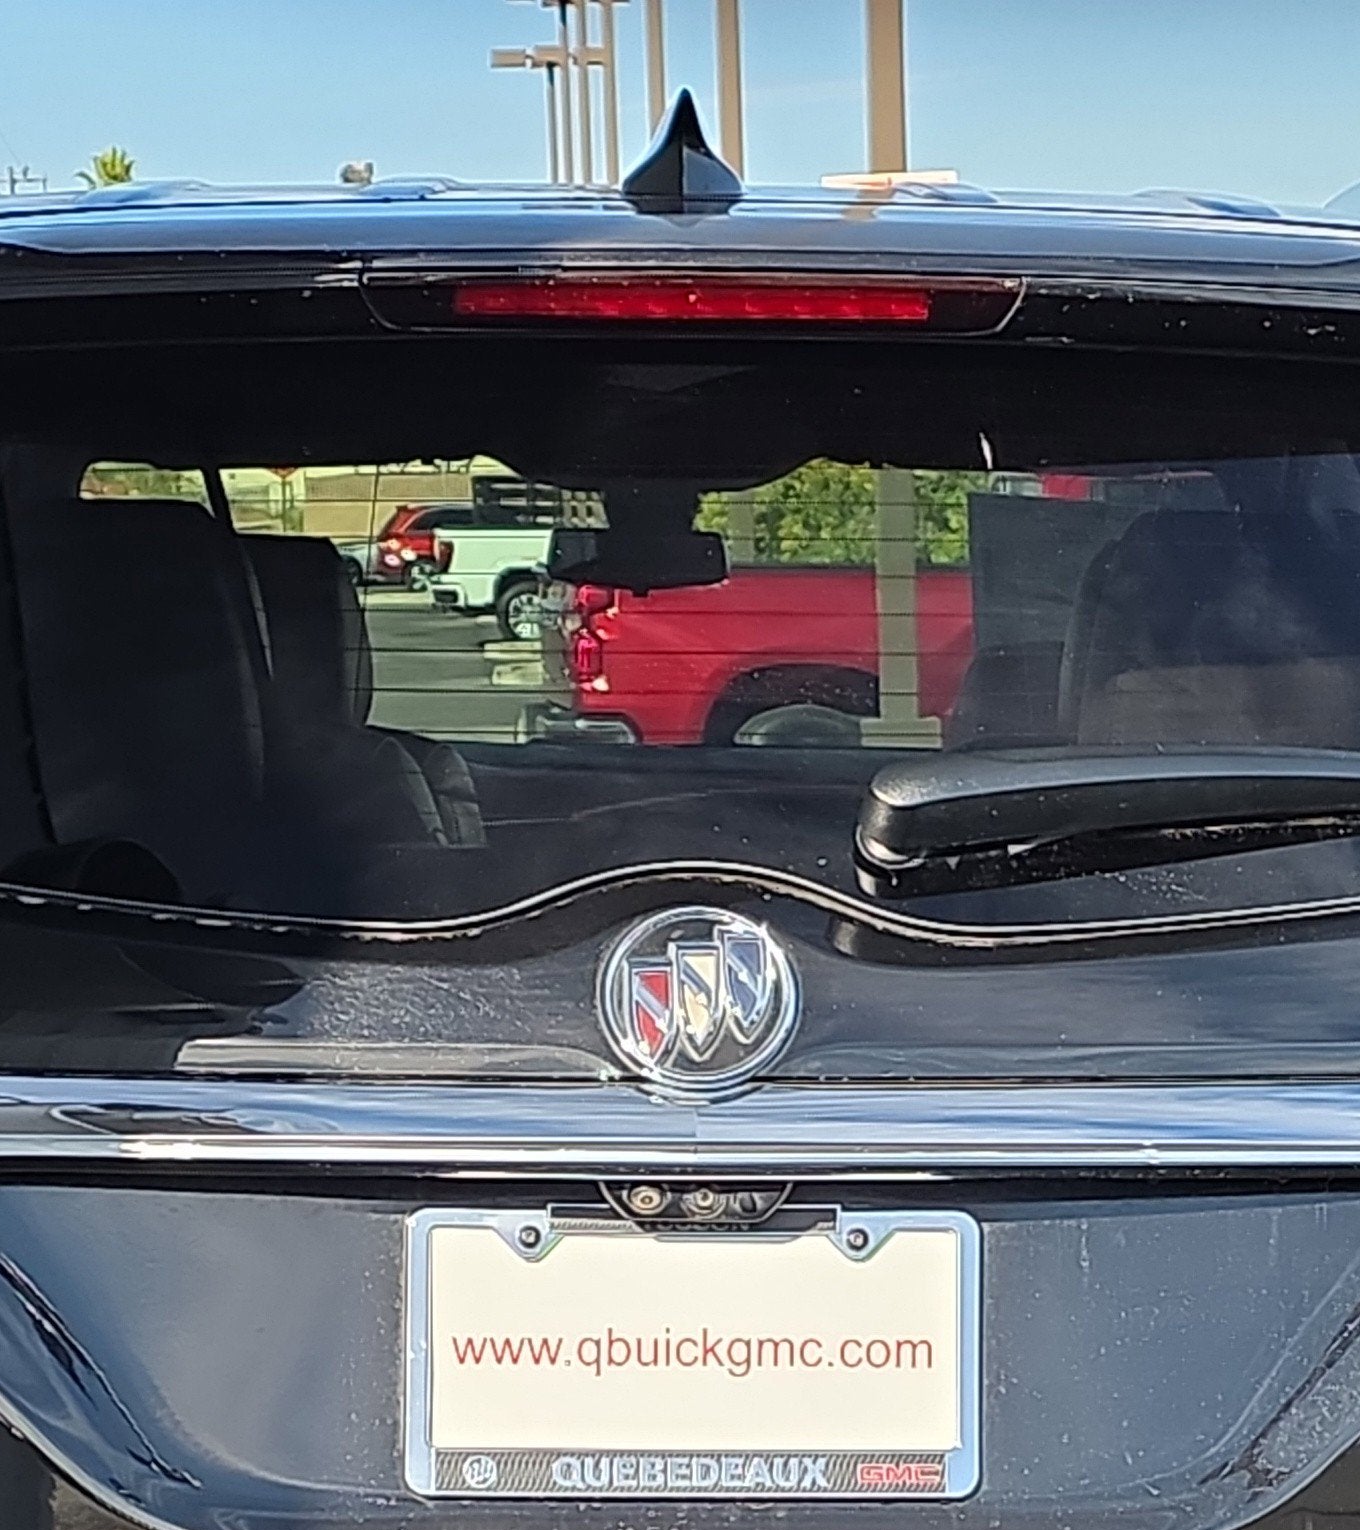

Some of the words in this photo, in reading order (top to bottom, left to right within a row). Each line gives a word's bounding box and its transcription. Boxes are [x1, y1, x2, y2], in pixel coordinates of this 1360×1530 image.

[451, 1327, 934, 1377] www.qbuickgmc.com
[552, 1455, 830, 1488] QUEBEDEAUX
[856, 1462, 942, 1484] GMC
